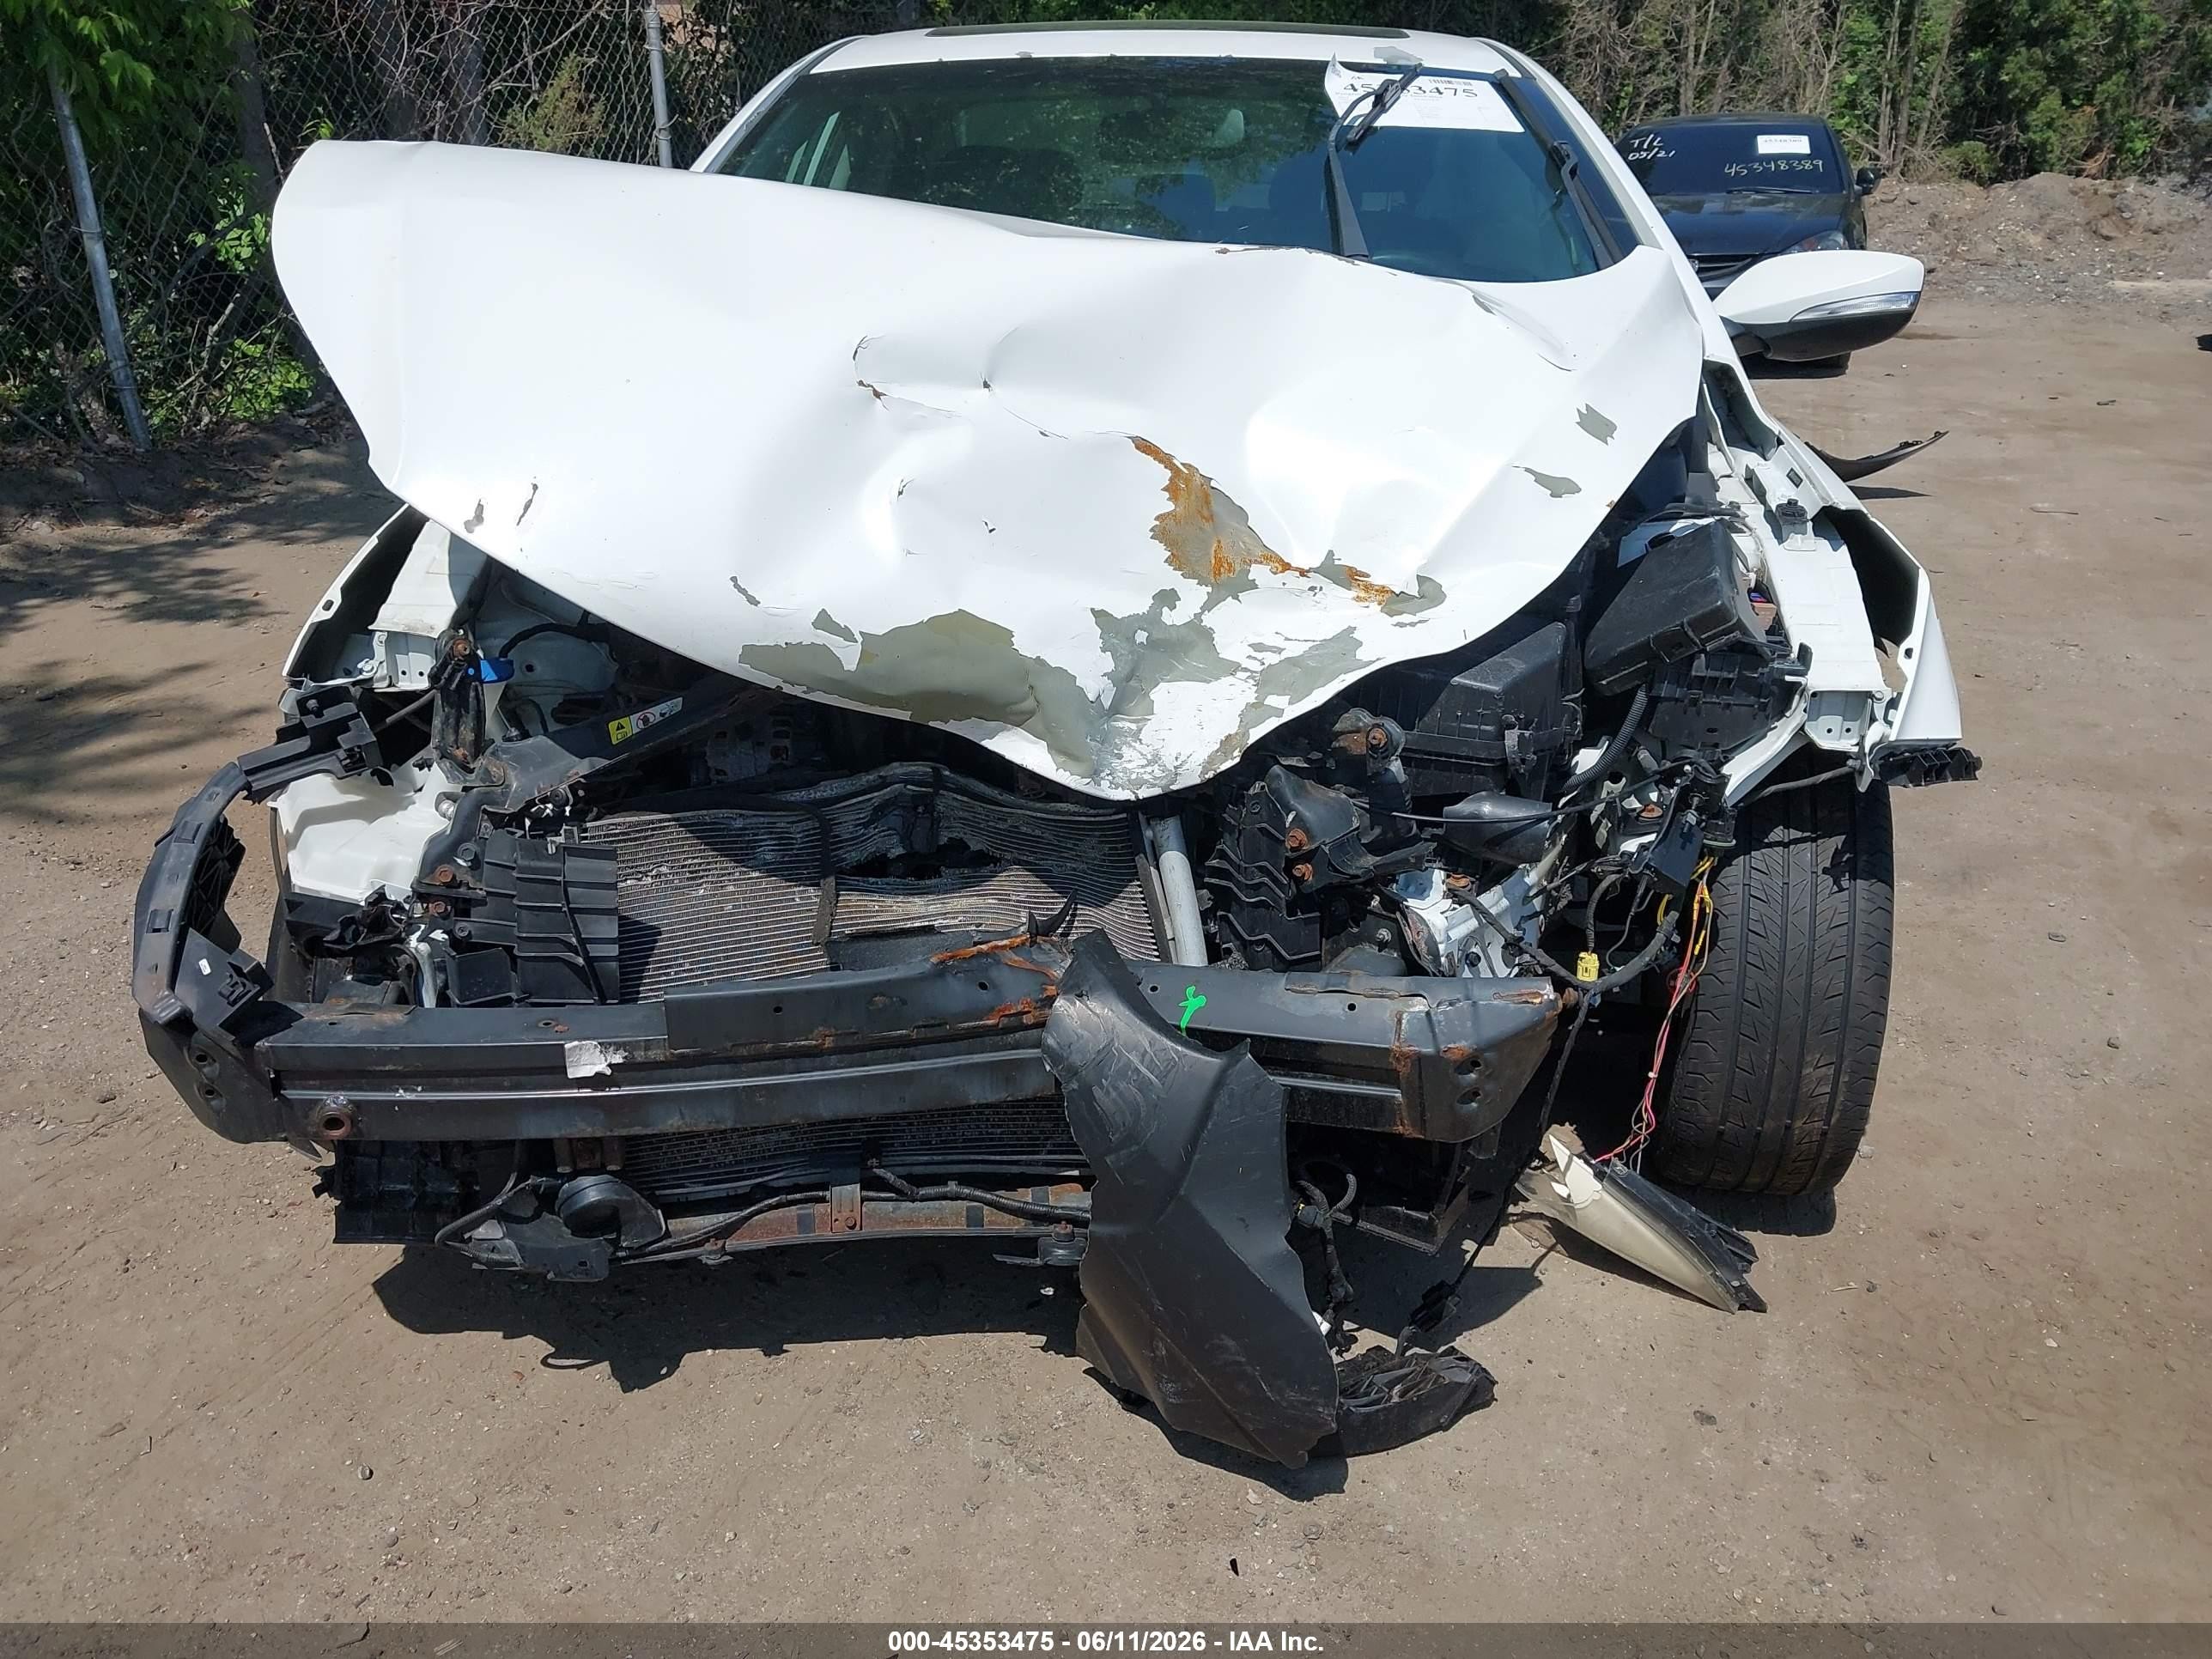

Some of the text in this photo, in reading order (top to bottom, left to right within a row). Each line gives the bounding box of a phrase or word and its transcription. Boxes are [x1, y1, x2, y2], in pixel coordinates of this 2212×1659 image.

[1343, 83, 1478, 99] 453475
[1630, 134, 1664, 149] T/L
[1627, 148, 1676, 161] 05/21
[1724, 159, 1823, 177] 45348389
